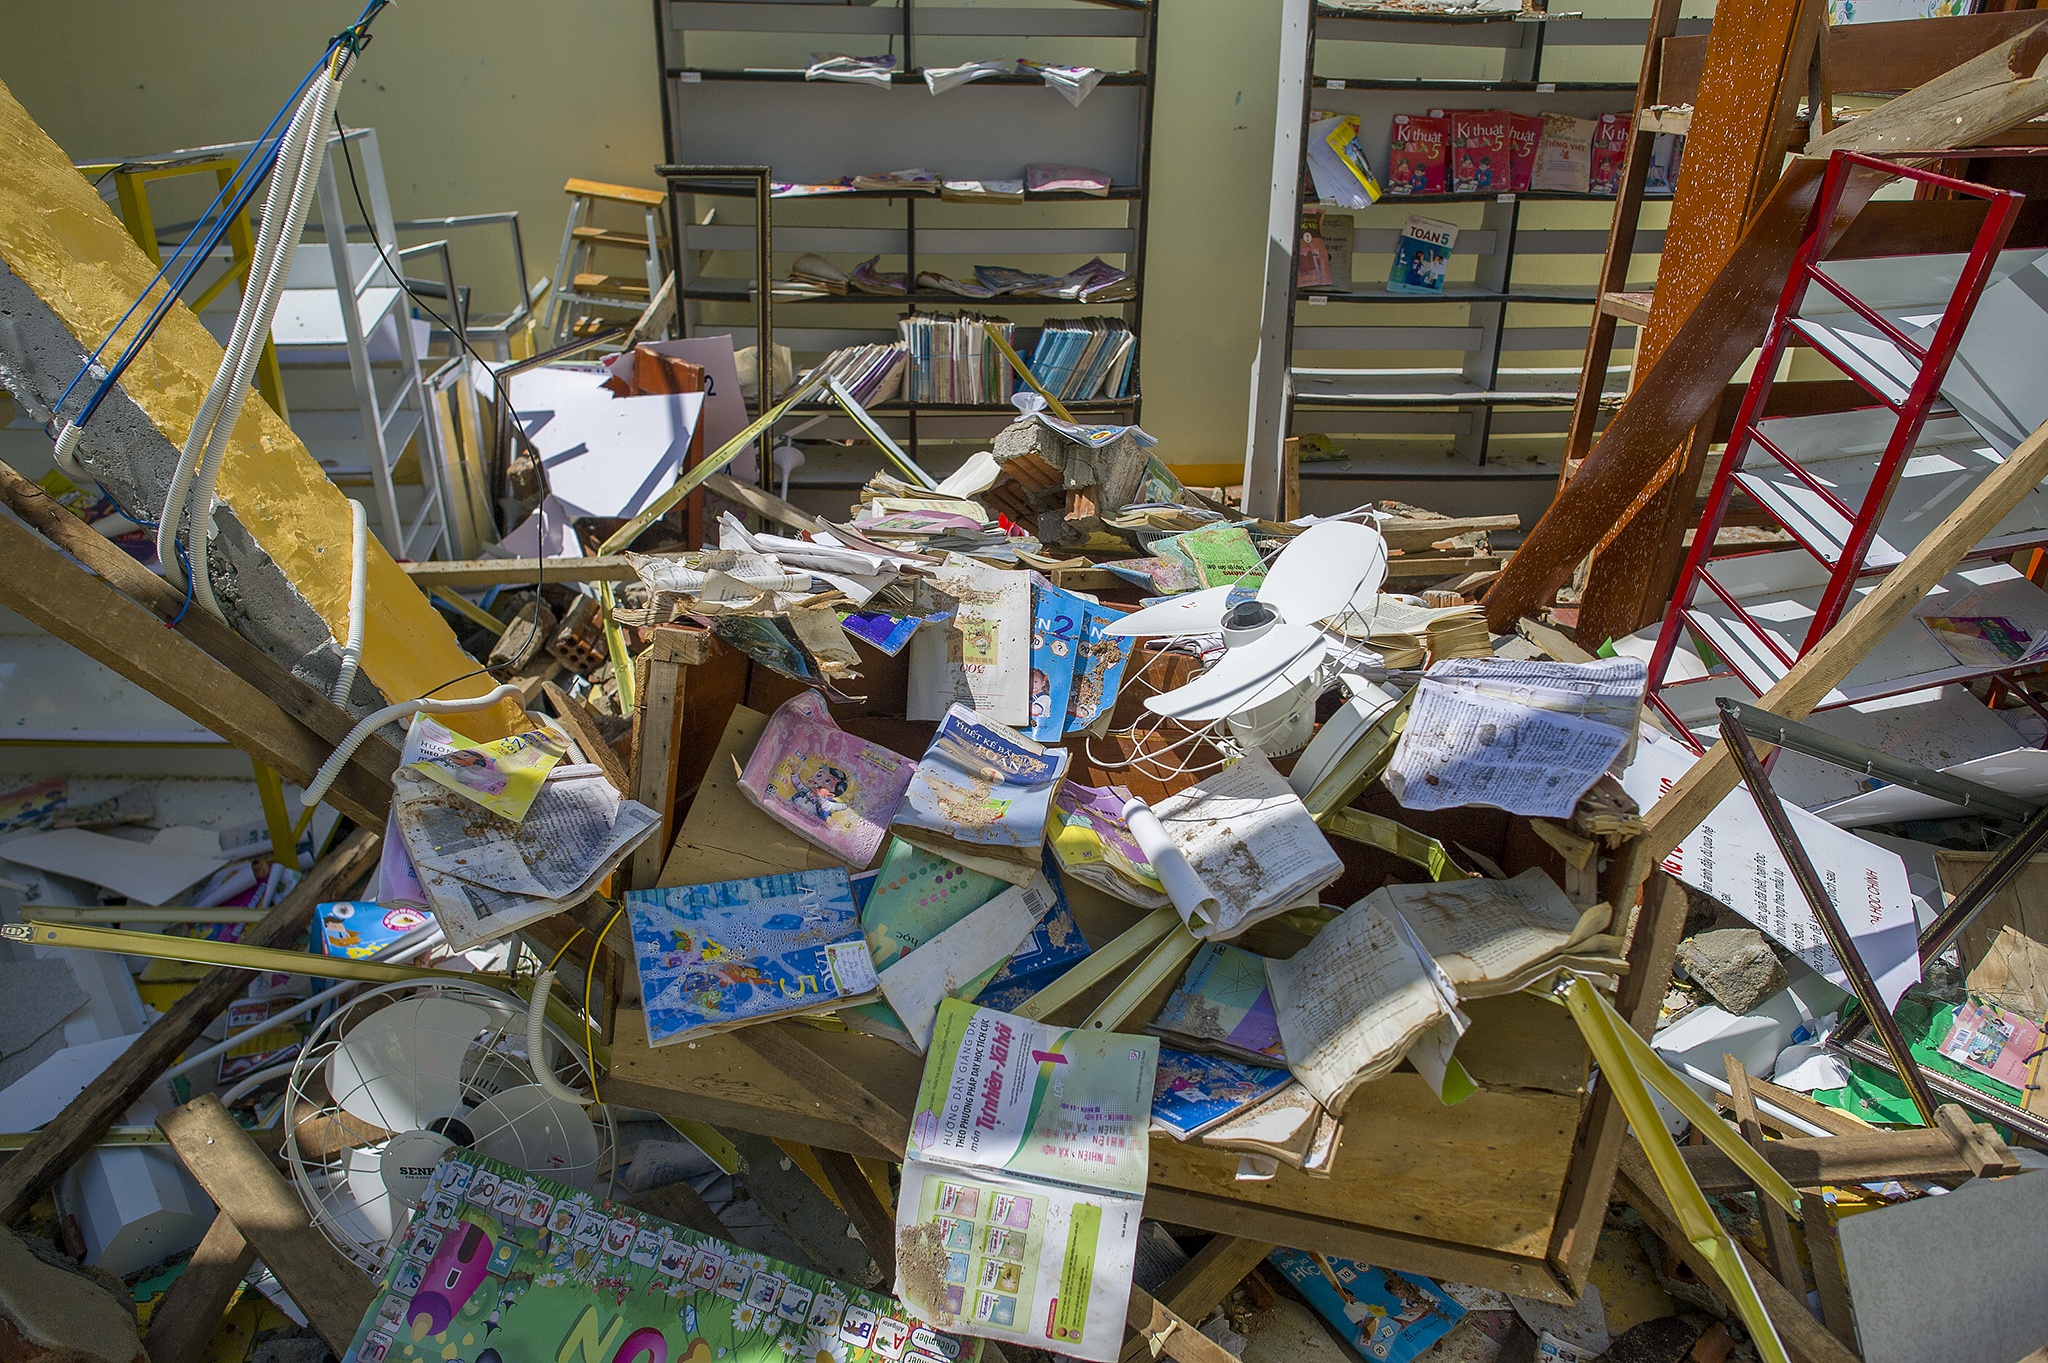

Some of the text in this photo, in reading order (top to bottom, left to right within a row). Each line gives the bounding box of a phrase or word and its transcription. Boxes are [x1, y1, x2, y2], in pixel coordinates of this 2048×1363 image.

[1413, 126, 1443, 145] thuật
[1473, 123, 1504, 138] thuật
[1510, 126, 1536, 143] huật
[1427, 143, 1442, 159] 5
[1492, 135, 1504, 152] 5
[1518, 142, 1535, 158] 5
[1411, 226, 1450, 245] TOÁN 5
[704, 374, 716, 396] 2
[1054, 615, 1073, 642] 2
[1080, 645, 1090, 653] 90
[953, 720, 998, 749] THIẾT KẾ
[420, 740, 456, 754] HƯỚN
[1698, 825, 1716, 882] ánh đầy đủ qua hệ
[1754, 852, 1768, 865] đọc
[1754, 865, 1768, 878] bạn
[1826, 869, 1836, 882] sau
[1770, 877, 1785, 891] mẫu
[1864, 867, 1884, 916] HỌC CHÍNH
[1755, 889, 1767, 901] đã
[1774, 892, 1785, 907] theo
[1754, 899, 1770, 914] giả
[1774, 906, 1788, 921] hợp
[1755, 911, 1768, 923] tác
[1773, 920, 1787, 938] thích
[1806, 923, 1822, 936] đề
[895, 931, 918, 946] học
[1792, 941, 1804, 953] tên
[1810, 937, 1826, 963] chuyên
[777, 971, 819, 1001] 5
[992, 1020, 1017, 1047] hội
[987, 1044, 1008, 1067] Xã
[1029, 1048, 1069, 1069] 1
[942, 1103, 958, 1146] HƯỚNG
[956, 1038, 973, 1073] GIẢNG
[966, 1015, 979, 1036] DẠY
[955, 1018, 991, 1148] THEO PHƯƠNG PHÁP DẠY HỌC TÍCH CỰC
[1051, 1078, 1065, 1098] LỚP
[979, 1070, 1003, 1112] nhiên
[975, 1109, 1001, 1131] Tự
[969, 1129, 981, 1152] môn
[1077, 1149, 1103, 1163] NHIÊN
[399, 1166, 435, 1175] SENK
[453, 1163, 470, 1173] Penguin
[457, 1176, 467, 1188] P
[483, 1183, 495, 1197] O
[532, 1190, 549, 1202] Monkey
[440, 1194, 454, 1203] Queen
[510, 1194, 523, 1209] N
[442, 1205, 453, 1219] Q
[534, 1203, 549, 1219] M
[584, 1211, 607, 1223] Kangaroo
[568, 1213, 577, 1229] L
[615, 1222, 632, 1232] Jaguar
[423, 1228, 440, 1239] Rooster
[590, 1223, 604, 1239] K
[643, 1233, 659, 1243] Iguana
[425, 1241, 437, 1255] R
[620, 1234, 631, 1249] J
[673, 1243, 687, 1253] Hippo
[675, 1255, 692, 1272] H
[703, 1254, 715, 1263] Goat
[703, 1263, 716, 1281] G
[733, 1265, 743, 1274] Fox
[1340, 1271, 1351, 1279] 10
[411, 1275, 421, 1288] S
[733, 1278, 745, 1292] F
[757, 1275, 779, 1286] Elephant
[763, 1286, 775, 1303] E
[788, 1287, 808, 1297] Dolphin
[391, 1298, 403, 1307] Tiger
[796, 1299, 808, 1315] D
[827, 1309, 839, 1325] C
[855, 1310, 868, 1319] Bear
[858, 1322, 872, 1339] B
[882, 1320, 905, 1332] Alligator
[1383, 1327, 1391, 1336] 70
[892, 1333, 906, 1350] A
[914, 1332, 956, 1355] December
[374, 1344, 386, 1360] U
[1376, 1345, 1385, 1354] 20
